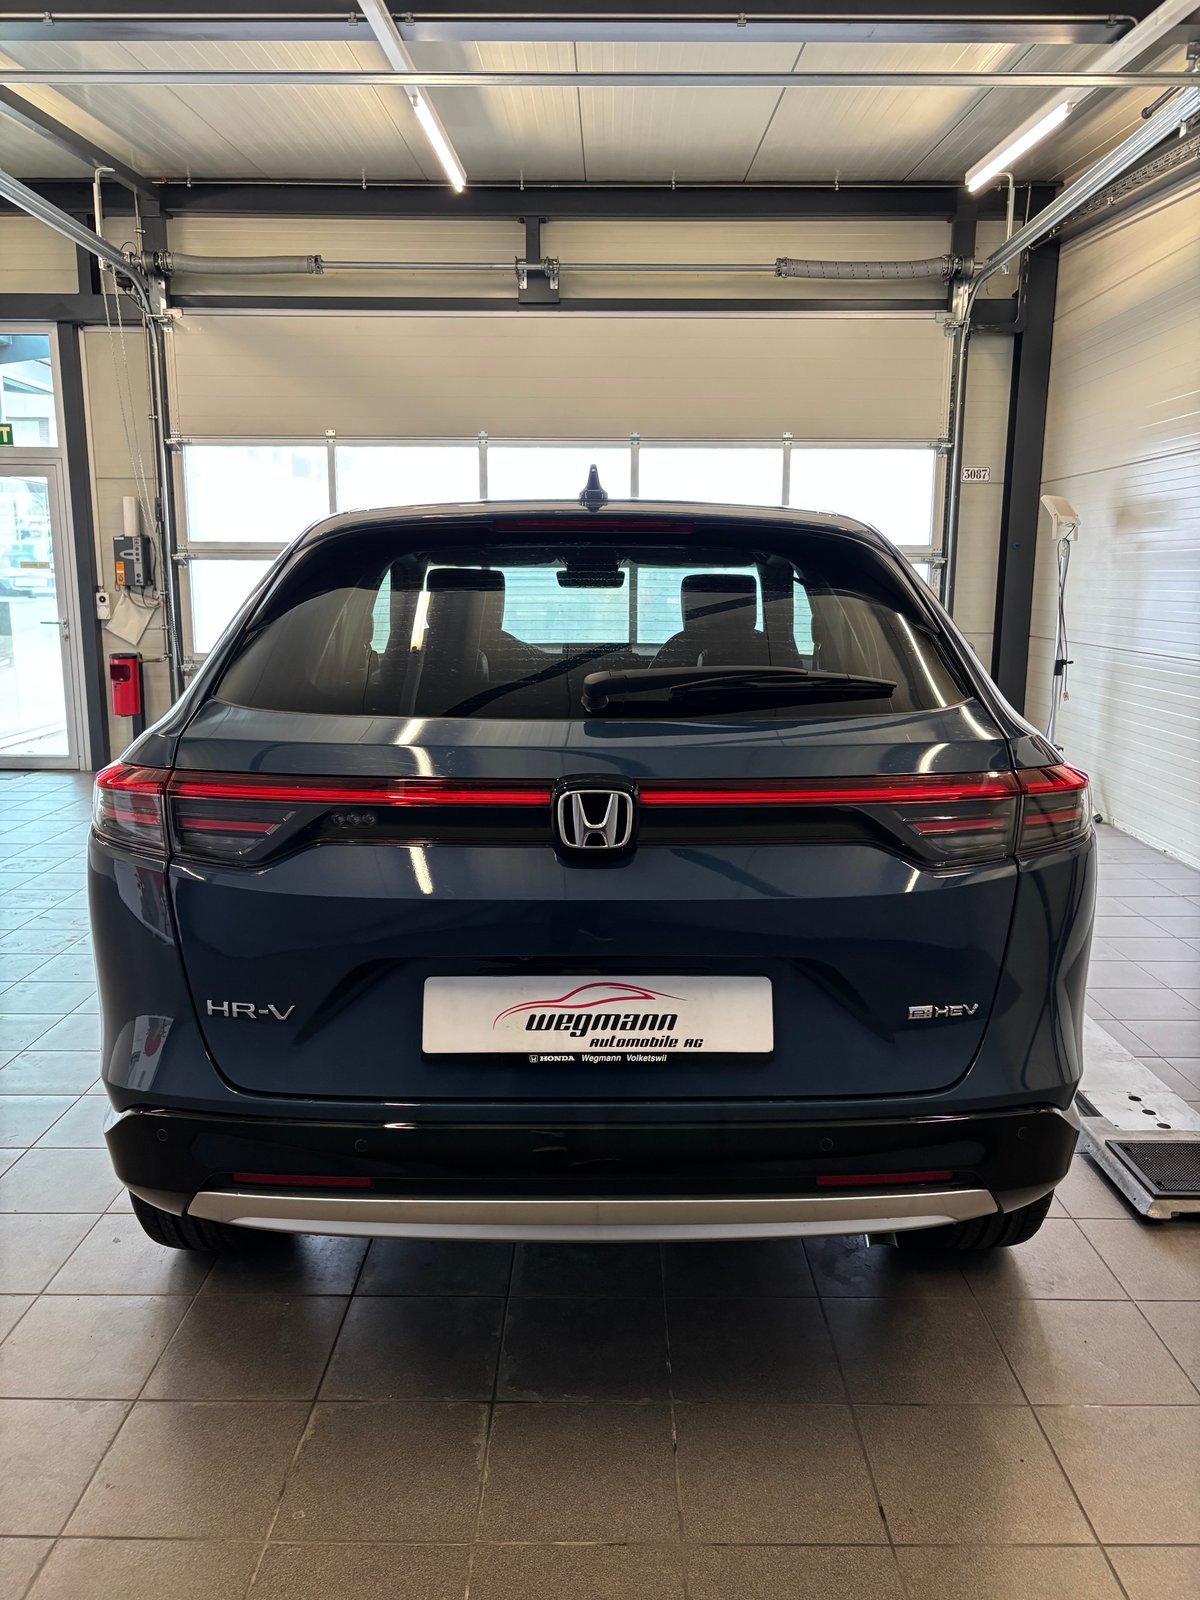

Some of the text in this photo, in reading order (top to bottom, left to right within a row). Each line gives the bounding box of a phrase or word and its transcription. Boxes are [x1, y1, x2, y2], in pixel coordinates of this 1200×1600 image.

[964, 469, 988, 479] 3087
[206, 999, 296, 1021] HR-V
[525, 1014, 678, 1037] wegmann
[683, 1038, 704, 1048] AG
[581, 1054, 622, 1064] Wegmann
[626, 1054, 668, 1062] Volketswil
